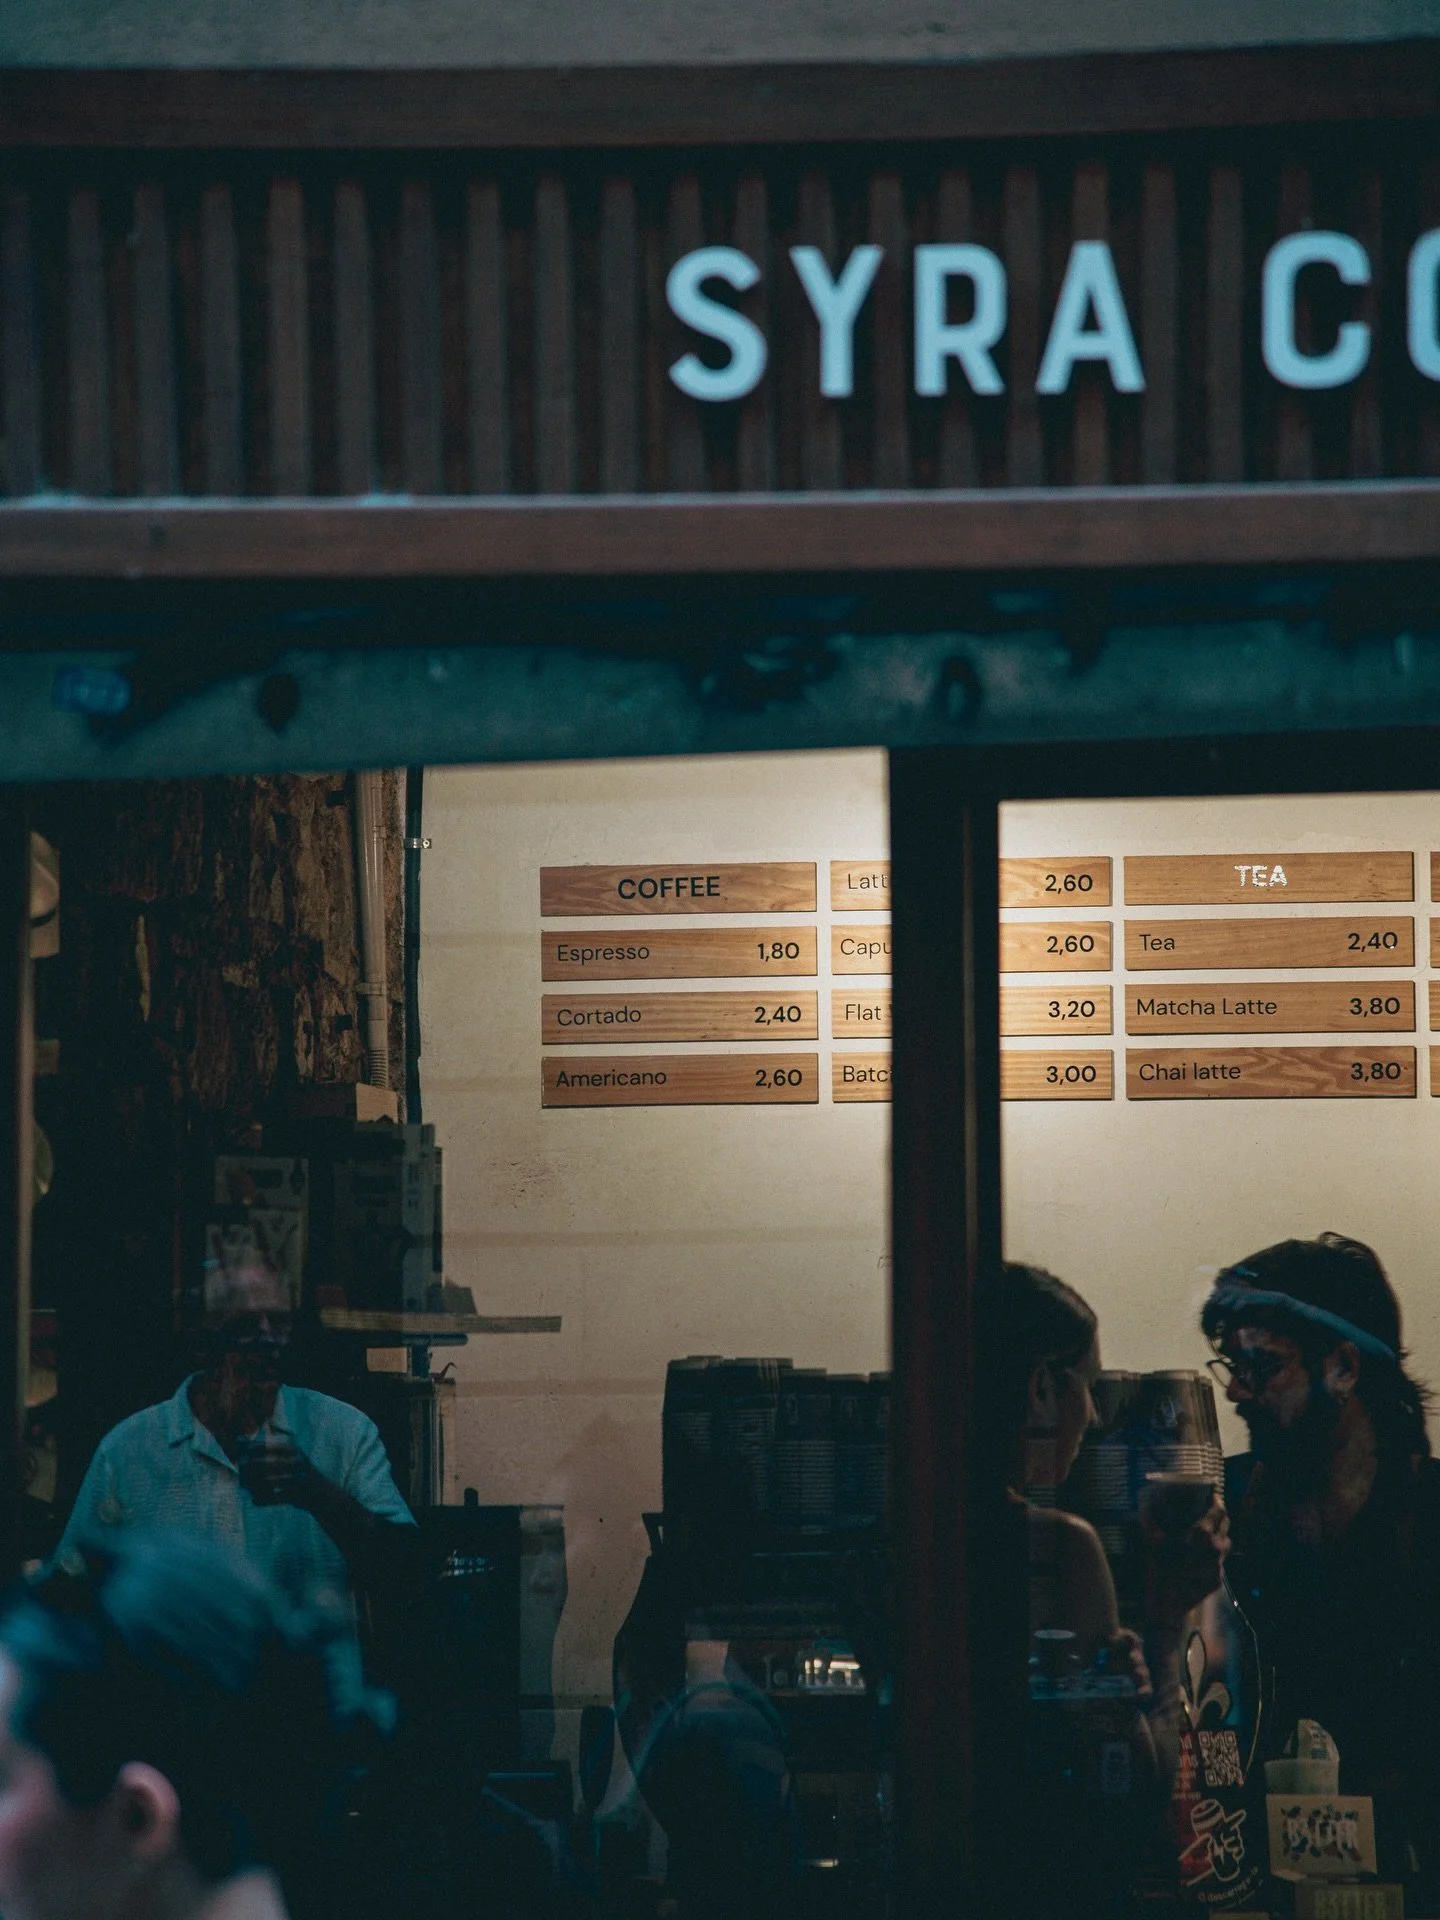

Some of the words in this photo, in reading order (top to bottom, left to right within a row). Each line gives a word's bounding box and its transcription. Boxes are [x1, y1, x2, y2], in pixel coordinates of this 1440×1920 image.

[665, 239, 1146, 401] SYRA
[1045, 874, 1093, 895] 2,60
[1234, 865, 1289, 887] TEA
[617, 875, 721, 900] COFFEE
[1046, 934, 1095, 956] 2,60
[1139, 933, 1175, 951] Tea
[1347, 931, 1398, 953] 2,40
[556, 943, 650, 966] Espresso
[757, 941, 800, 962] 1,80
[556, 1004, 642, 1026] Cortado
[754, 1005, 802, 1026] 2,40
[845, 1003, 882, 1021] Flat
[1048, 1000, 1096, 1021] 3,20
[1136, 998, 1215, 1016] Matcha
[1222, 997, 1278, 1015] Latte
[1349, 997, 1401, 1018] 3,80
[555, 1068, 667, 1088] Americano
[755, 1068, 803, 1088] 2,60
[842, 1065, 892, 1083] Batc
[1046, 1065, 1097, 1086] 3,00
[1138, 1062, 1186, 1081] Chai
[1193, 1062, 1242, 1080] latte
[1350, 1062, 1401, 1083] 3,80
